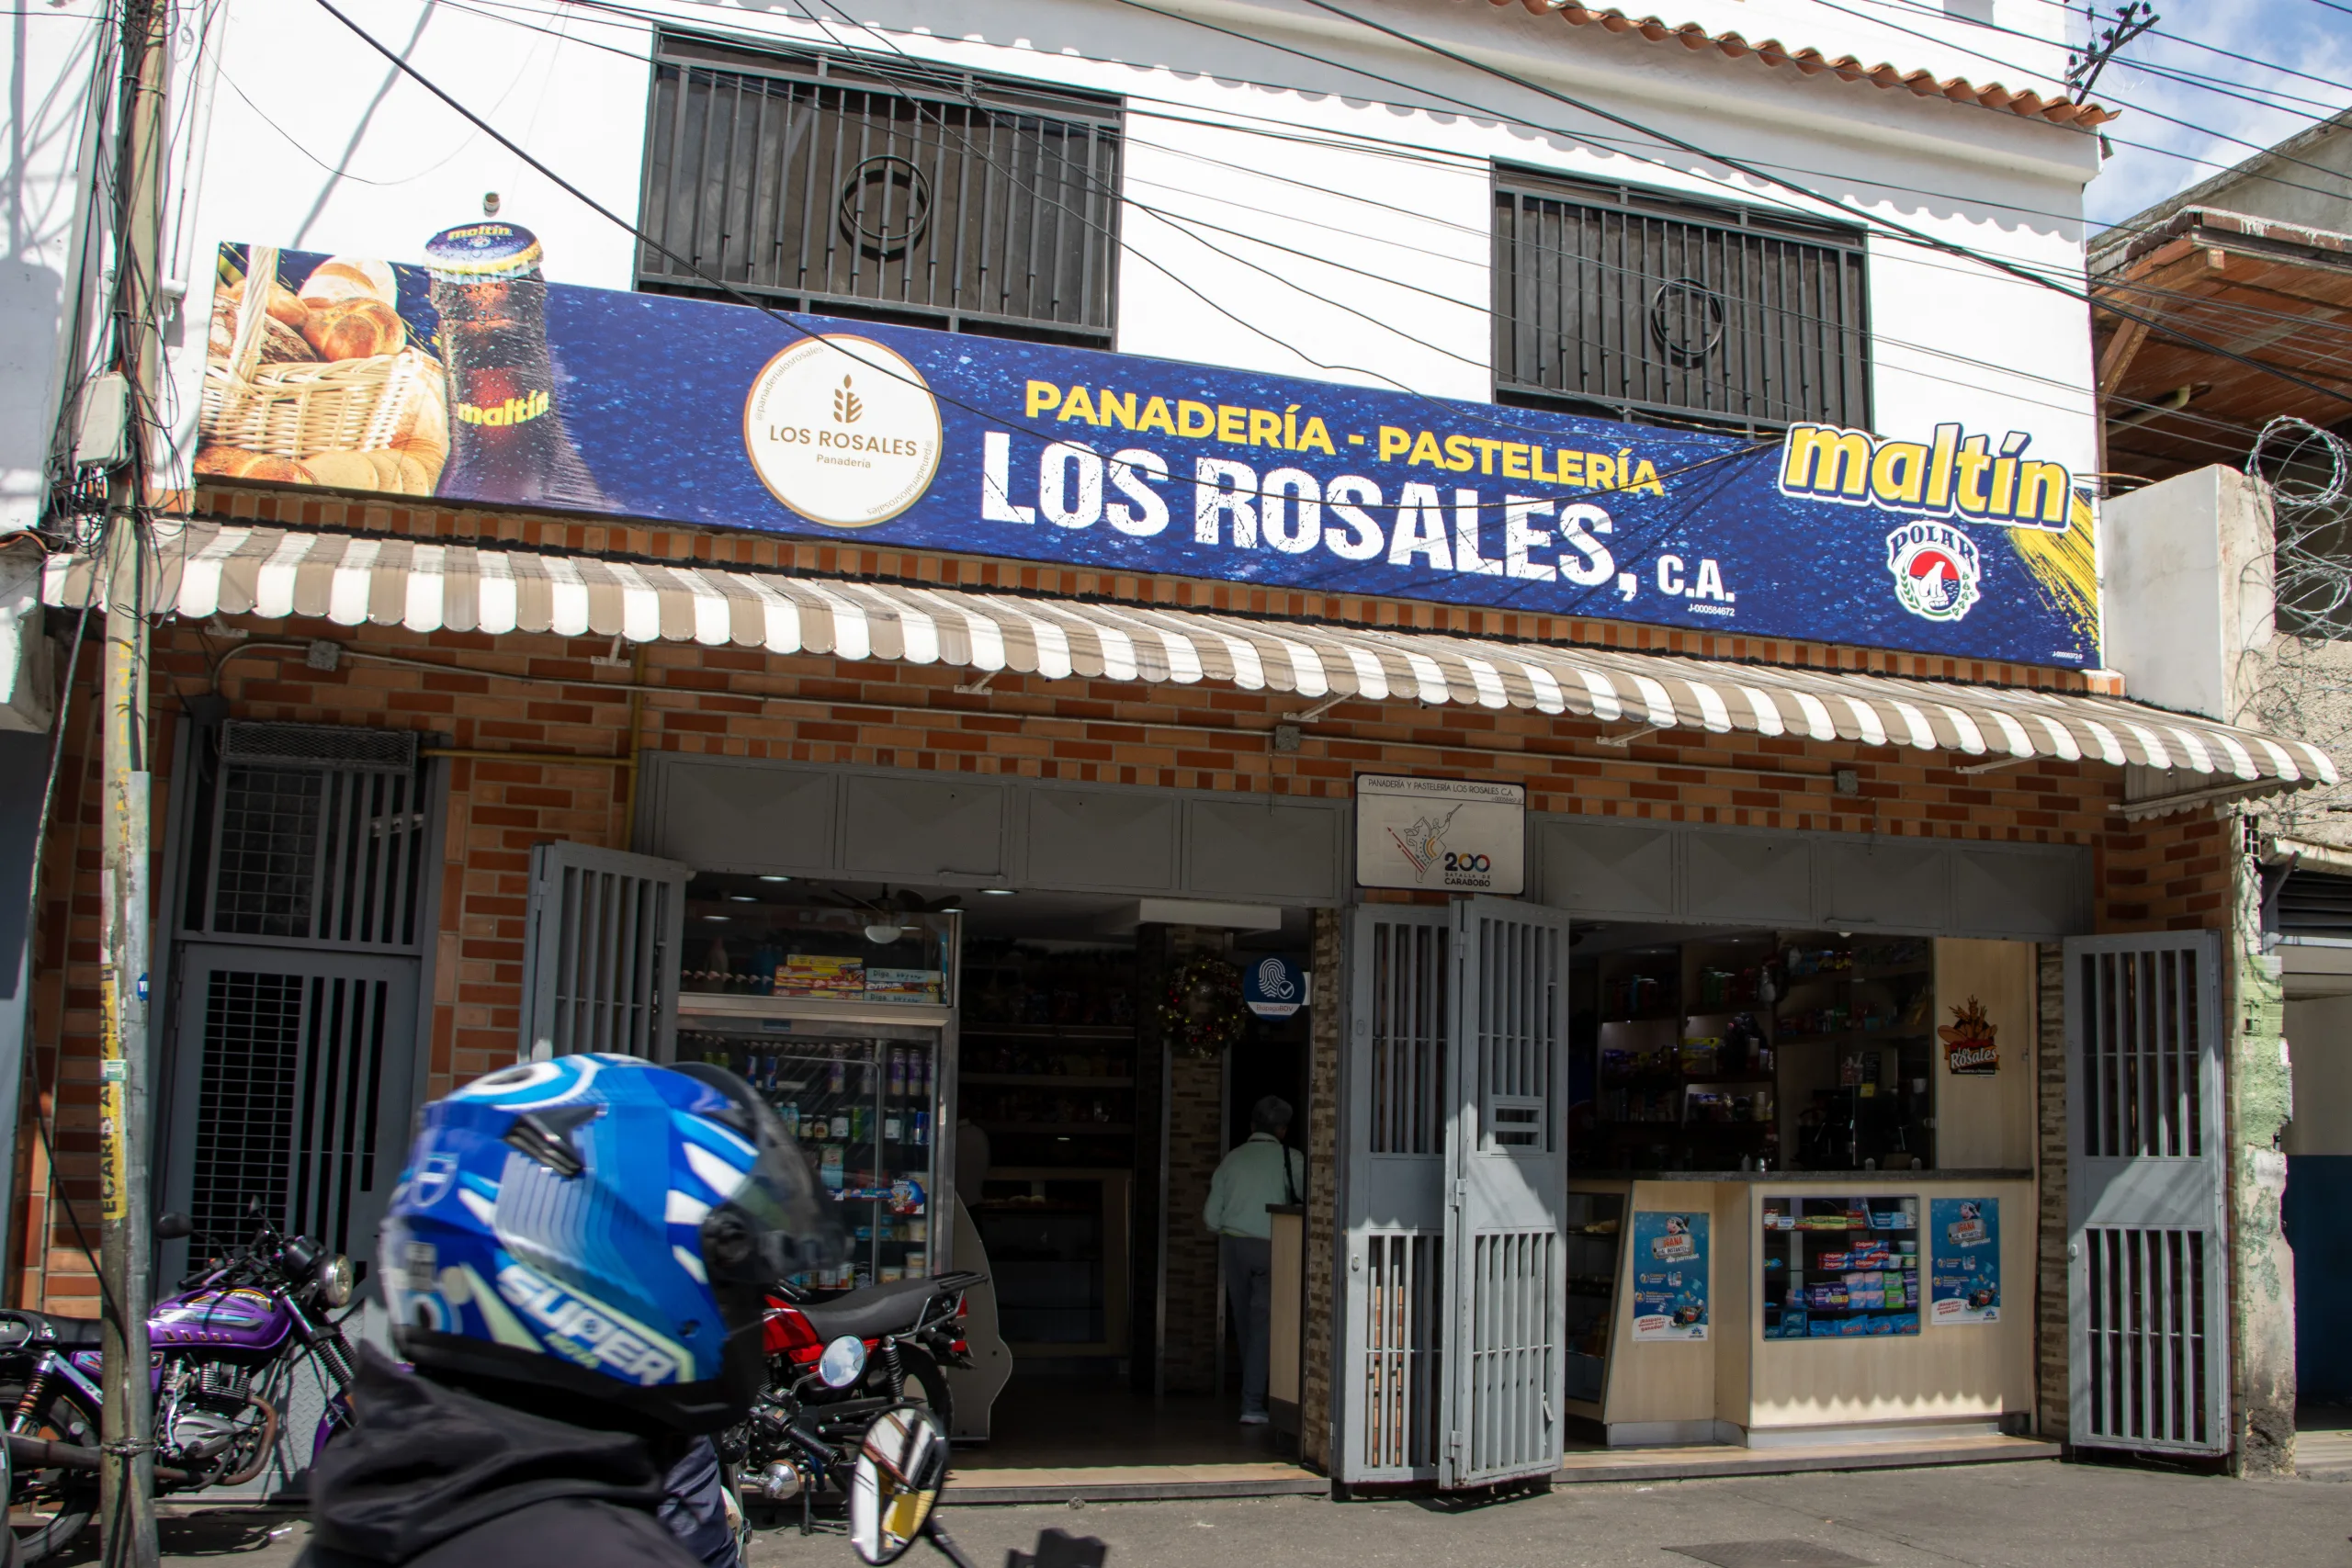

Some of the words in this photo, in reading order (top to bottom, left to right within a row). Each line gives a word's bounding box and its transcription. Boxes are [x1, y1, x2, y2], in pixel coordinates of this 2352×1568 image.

[458, 389, 550, 426] maltín
[770, 424, 811, 446] LOS
[819, 430, 918, 457] ROSALES
[1024, 379, 1336, 456] PANADERÍA
[1349, 434, 1365, 446] -
[1378, 424, 1665, 497] PASTELERÍA
[816, 454, 872, 469] Panadería
[1781, 422, 2073, 528] maltín
[981, 431, 1171, 537] LOS
[1193, 457, 1639, 602] ROSALES,
[1657, 554, 1735, 603] C.A.
[1891, 525, 1975, 572] POLAR
[1368, 779, 1405, 789] PANADERÍA
[1413, 782, 1452, 793] PASTELERÍA
[1453, 784, 1468, 794] LOS
[1469, 785, 1499, 795] ROSALES
[1444, 852, 1490, 872] 200
[1444, 877, 1490, 887] CARABOBO
[1951, 1047, 1996, 1069] Rosales
[1958, 1047, 1970, 1056] Los
[497, 1263, 681, 1385] SUPER
